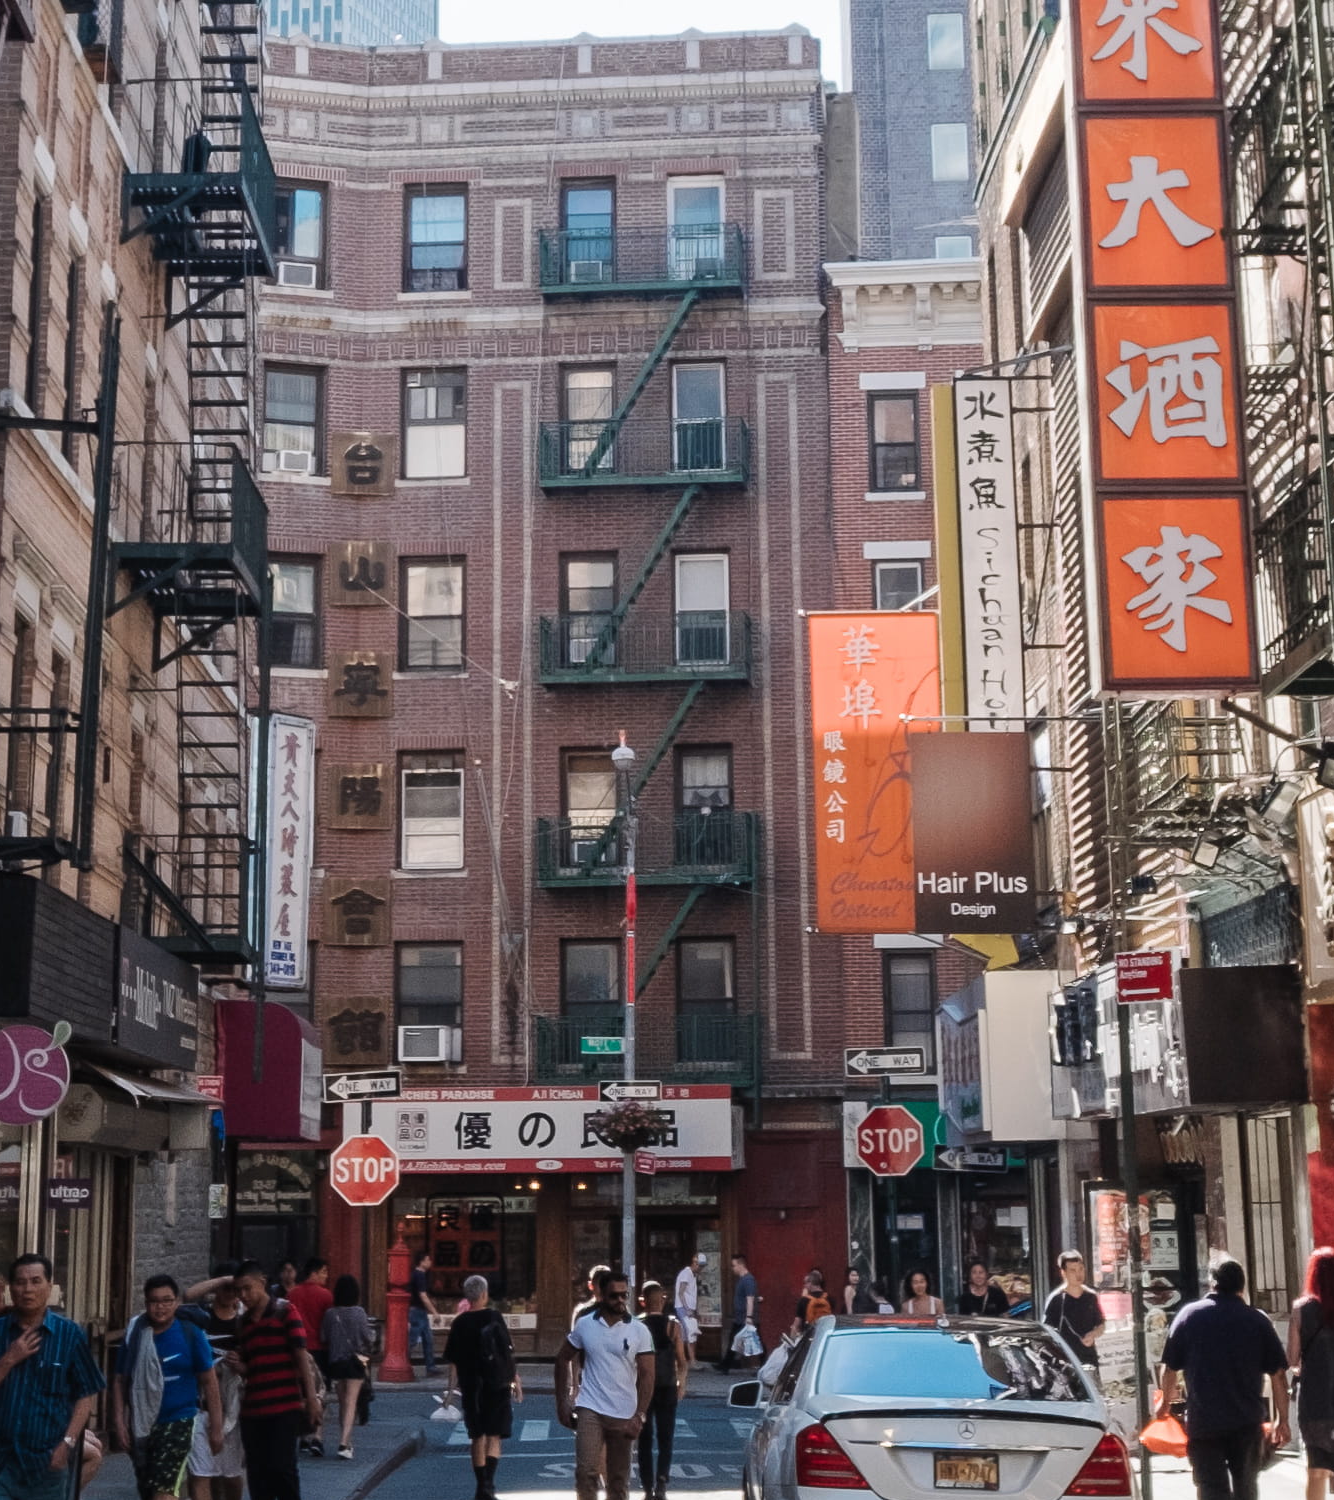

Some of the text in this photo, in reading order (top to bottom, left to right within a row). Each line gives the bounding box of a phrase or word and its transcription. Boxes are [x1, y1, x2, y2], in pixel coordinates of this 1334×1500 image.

[963, 391, 1006, 511] 水煮魚
[977, 527, 1007, 657] Sichuan
[839, 624, 882, 730] 華埠
[822, 730, 848, 843] 眼鏡公司
[830, 871, 915, 896] Chinato
[918, 871, 1028, 894] Hair Plus
[950, 902, 996, 918] Design
[856, 1055, 917, 1067] ONE WAY
[337, 1080, 391, 1092] ONE WAY
[441, 1090, 495, 1099] PARADISE
[608, 1087, 654, 1096] ONE WAY
[860, 1128, 918, 1154] STOP
[335, 1156, 395, 1184] STOP
